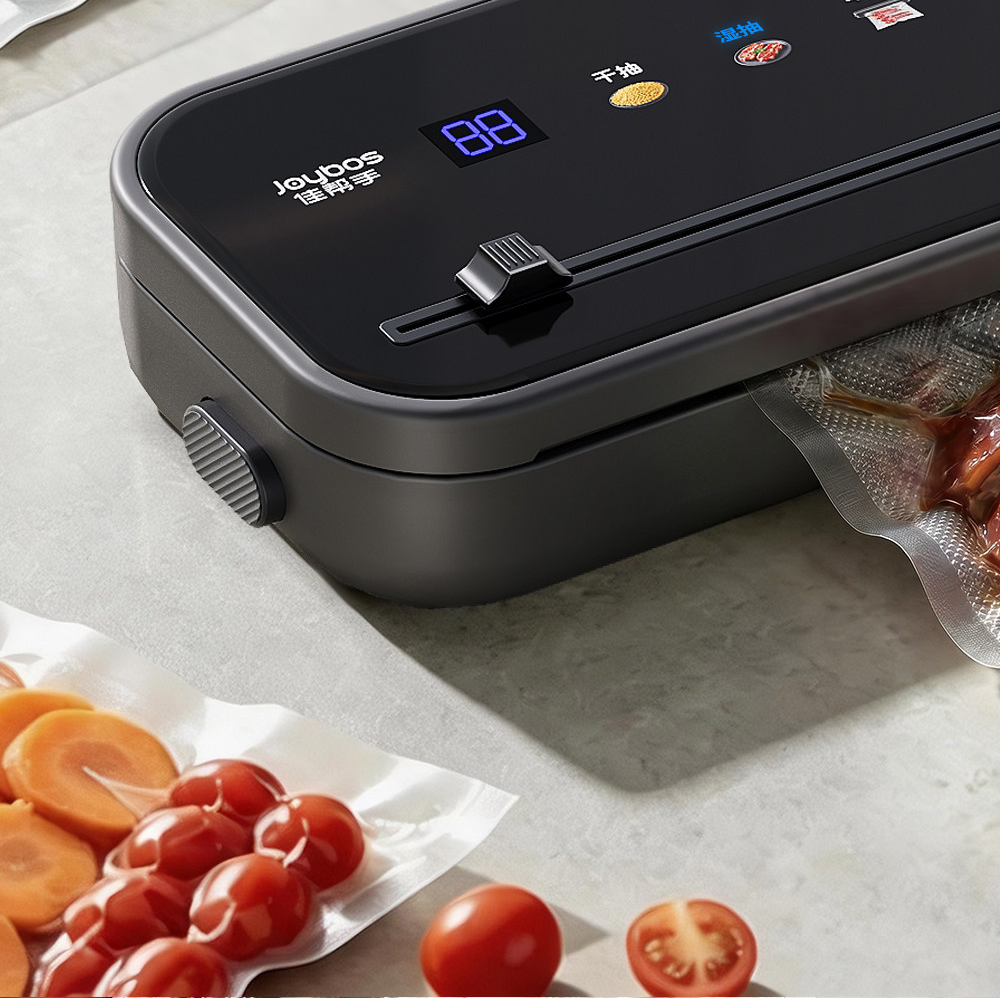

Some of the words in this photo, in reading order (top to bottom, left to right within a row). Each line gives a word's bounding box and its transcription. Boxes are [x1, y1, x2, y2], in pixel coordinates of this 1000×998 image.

[714, 20, 764, 44] 湿抽
[591, 61, 644, 83] 干抽
[440, 108, 528, 157] 88
[272, 149, 385, 197] Joybos
[293, 168, 382, 206] 佳帮手
